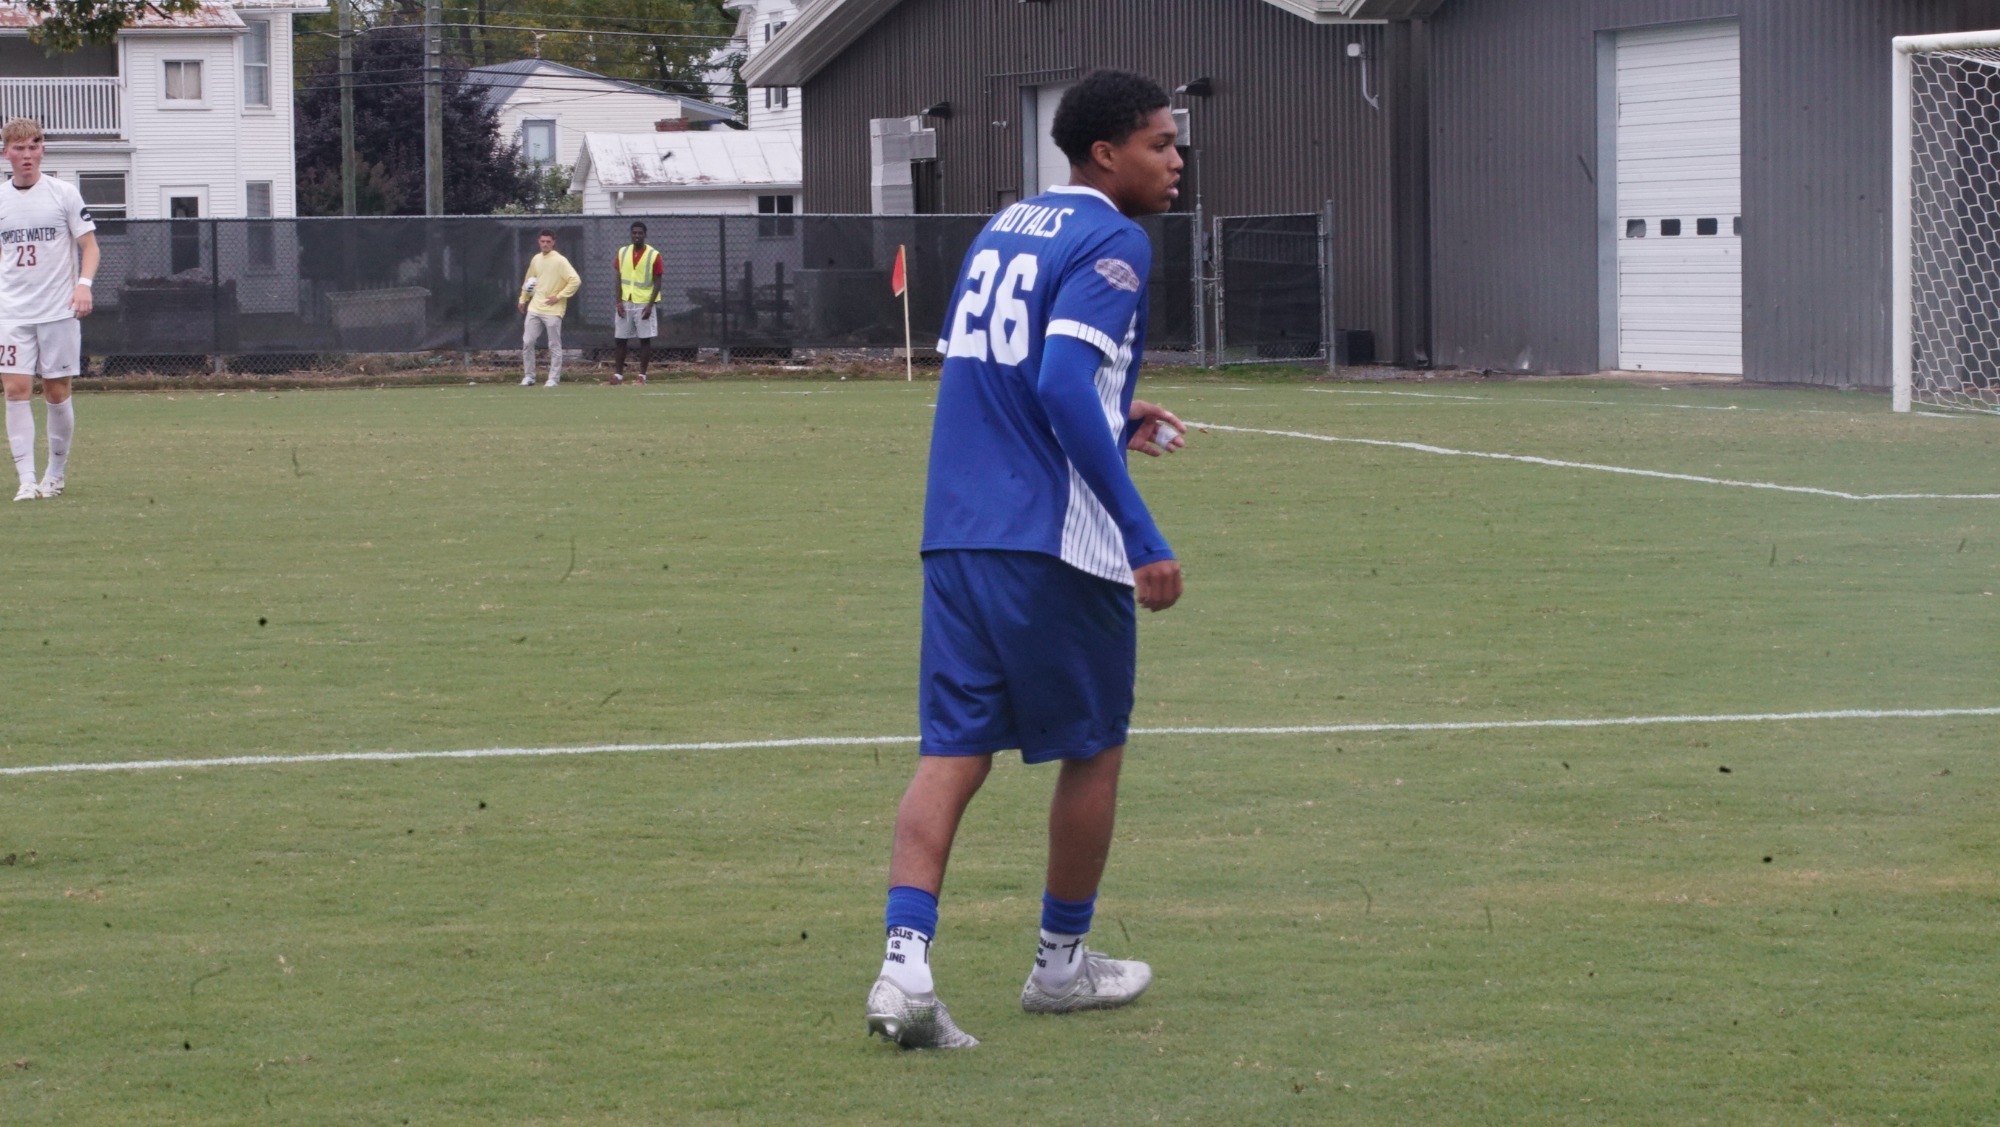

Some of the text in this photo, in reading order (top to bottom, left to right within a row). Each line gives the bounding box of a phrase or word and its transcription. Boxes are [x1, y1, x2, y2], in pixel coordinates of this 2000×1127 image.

[991, 203, 1075, 238] ROYALS
[17, 245, 36, 267] 23
[947, 249, 1038, 366] 26
[891, 940, 901, 949] IS
